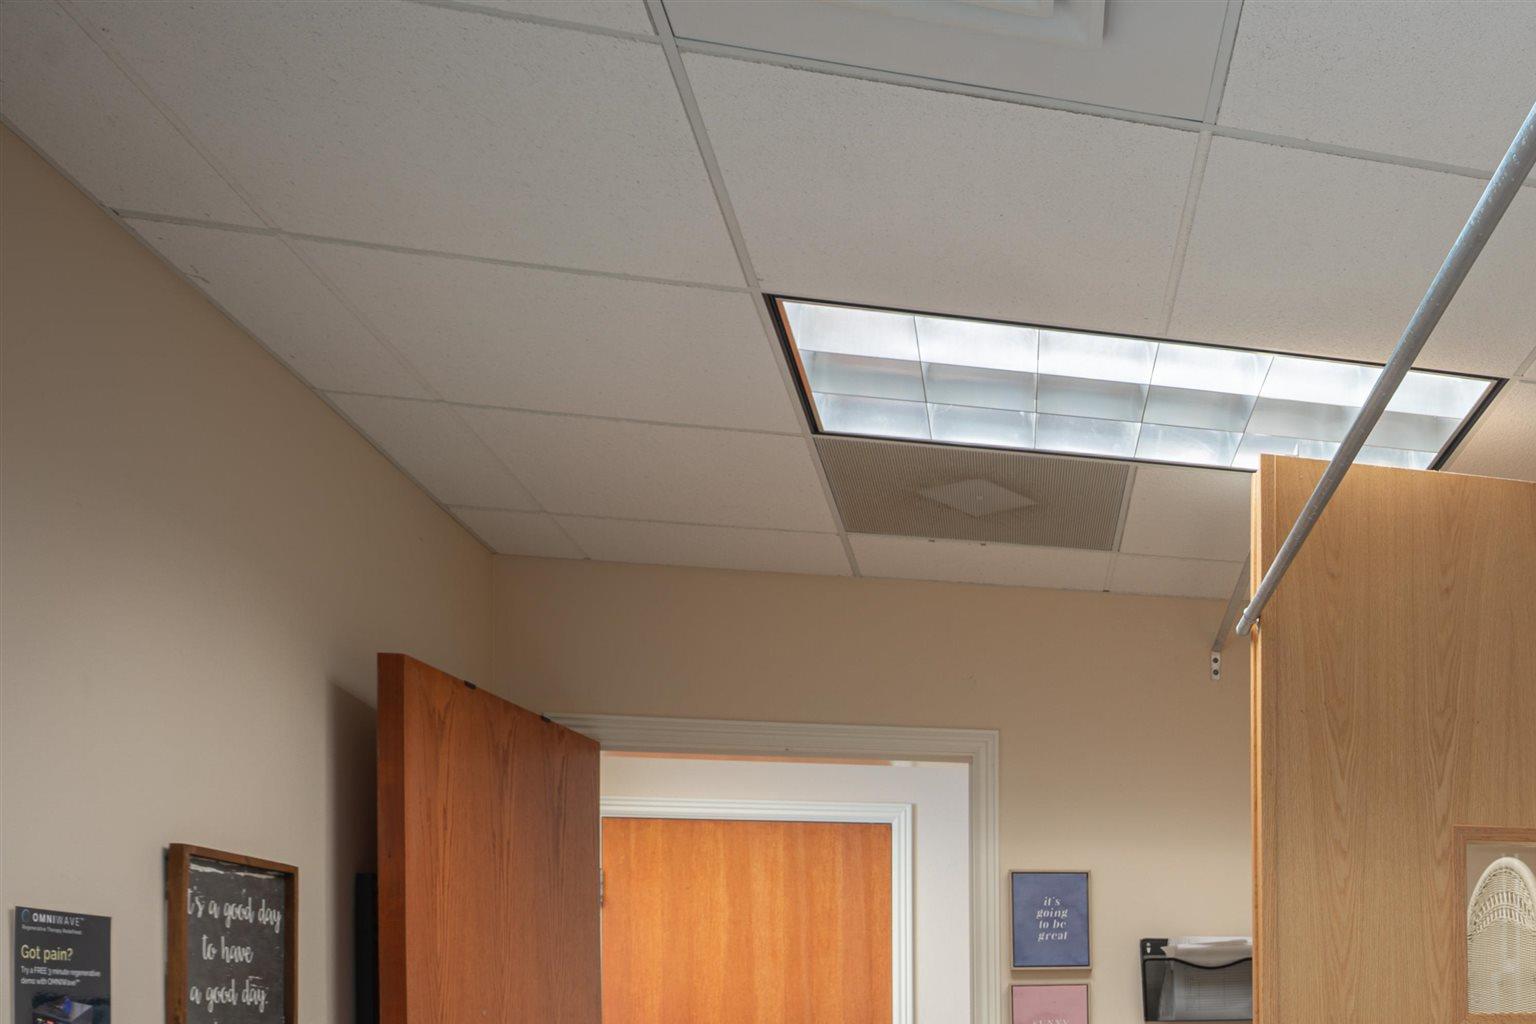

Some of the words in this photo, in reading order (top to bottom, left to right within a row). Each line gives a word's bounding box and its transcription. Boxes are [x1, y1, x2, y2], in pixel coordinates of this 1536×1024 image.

[1044, 896, 1060, 906] it's
[208, 900, 220, 918] a
[223, 897, 255, 928] good
[258, 899, 281, 934] day
[1036, 908, 1068, 919] going
[1039, 920, 1049, 928] to
[1053, 919, 1066, 928] be
[1038, 931, 1067, 942] great
[21, 944, 40, 959] Got
[44, 947, 73, 963] pain?
[201, 934, 217, 960] to
[221, 936, 253, 963] have
[190, 986, 202, 1004] a
[206, 979, 238, 1013] good
